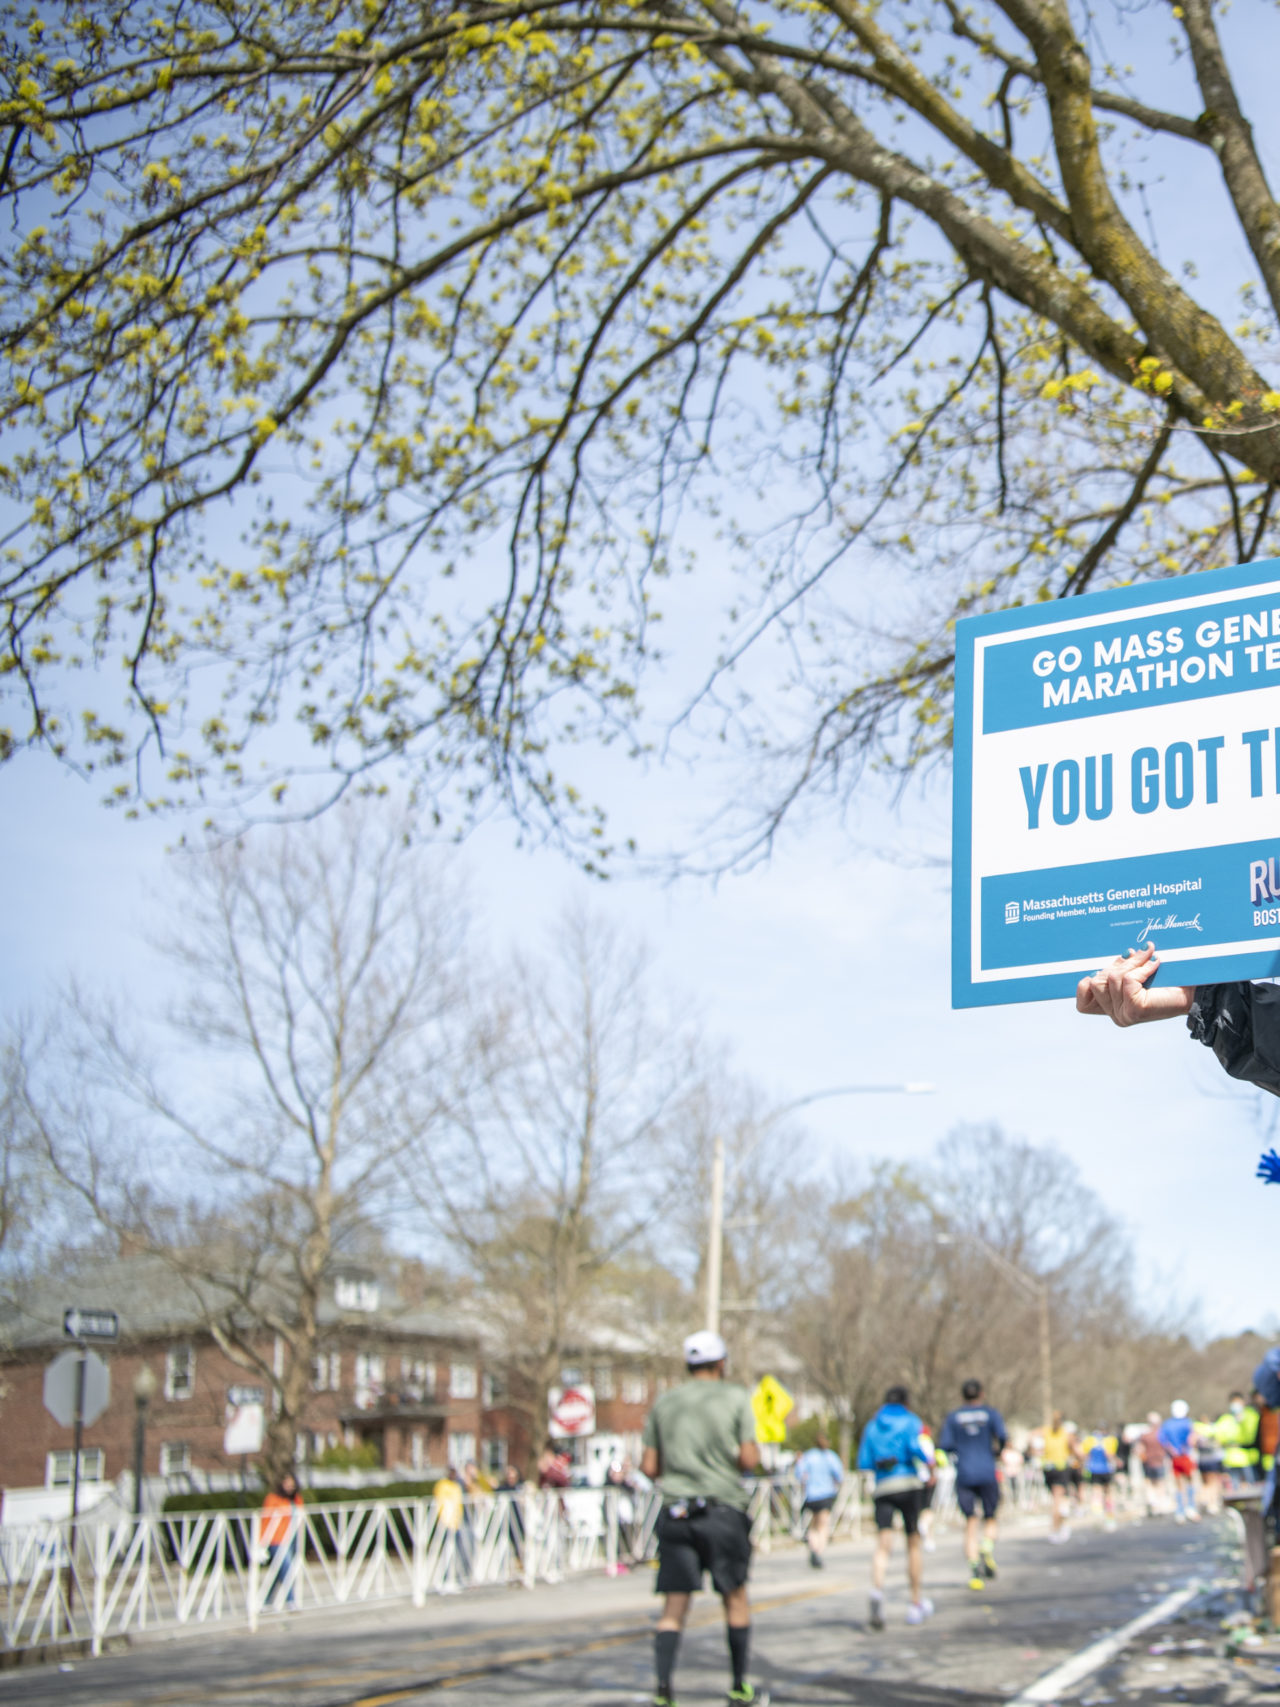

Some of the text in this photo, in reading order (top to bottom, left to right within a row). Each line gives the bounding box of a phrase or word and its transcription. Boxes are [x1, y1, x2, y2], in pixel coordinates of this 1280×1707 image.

[1032, 645, 1083, 677] GO
[1094, 627, 1185, 667] MASS
[1043, 650, 1234, 708] MARATHON
[1019, 753, 1113, 830] YOU
[1131, 735, 1225, 815] GOT
[1022, 877, 1202, 912] Massachusetts General Hospital
[1023, 898, 1168, 922] Founding Member, Mass General Brigham
